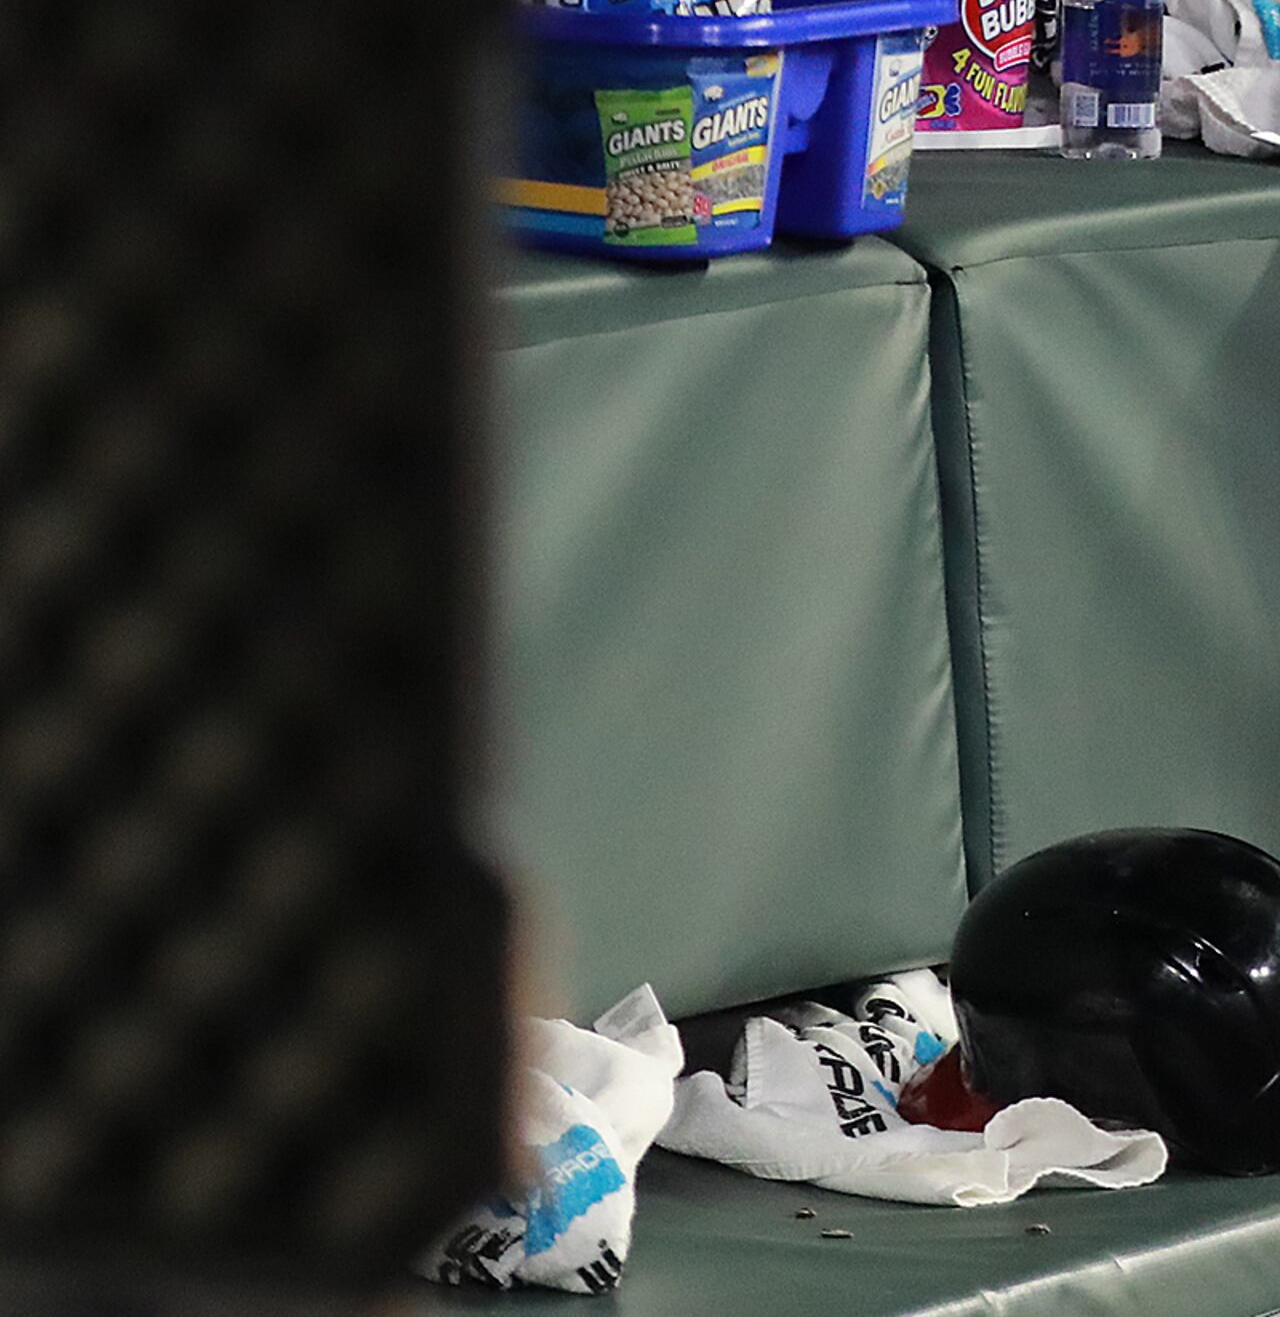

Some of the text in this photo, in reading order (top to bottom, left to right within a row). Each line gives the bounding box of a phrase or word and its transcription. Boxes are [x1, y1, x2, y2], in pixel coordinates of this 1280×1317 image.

[952, 48, 972, 73] 4
[966, 62, 996, 100] FUN
[608, 119, 685, 155] GIANTS
[692, 96, 769, 150] GIANTS
